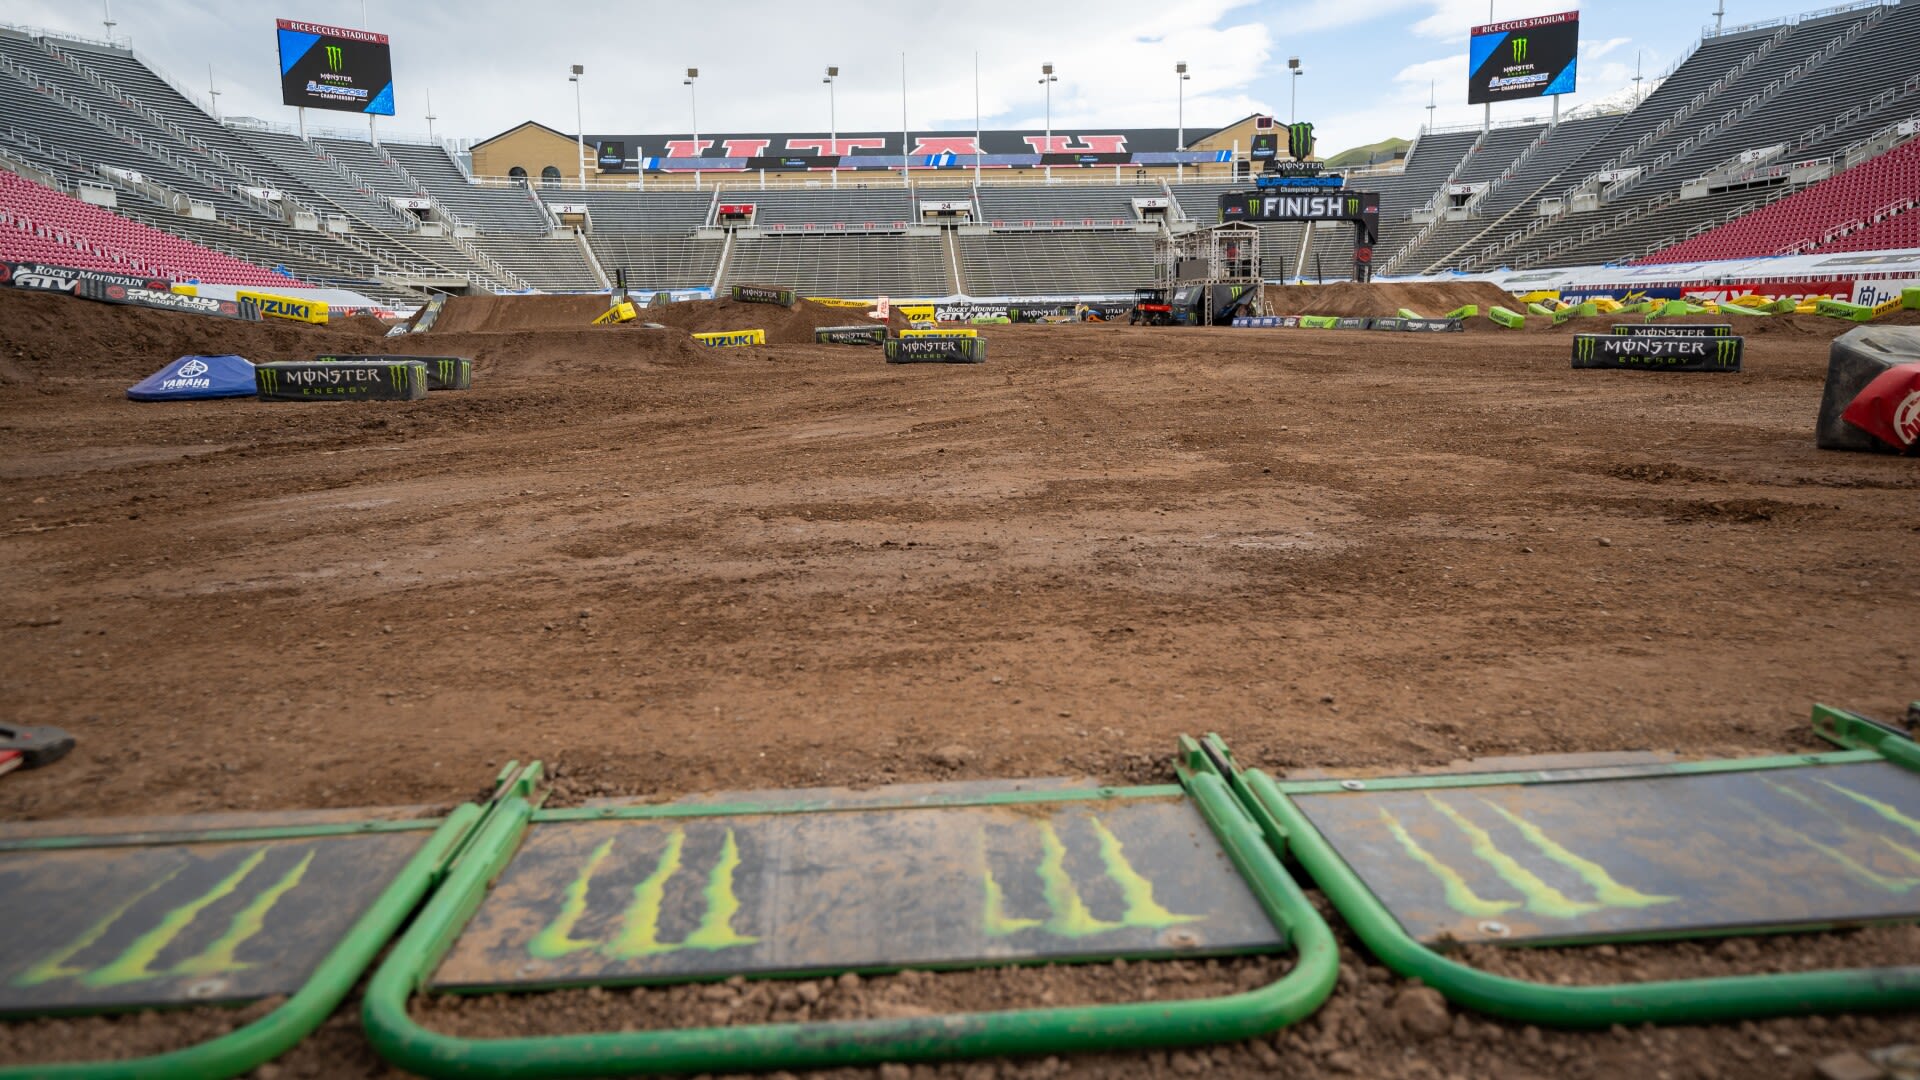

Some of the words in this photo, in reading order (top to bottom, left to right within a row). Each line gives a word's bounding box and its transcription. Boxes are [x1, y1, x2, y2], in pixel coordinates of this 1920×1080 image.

[1482, 20, 1528, 34] RICE-ECCLES
[1529, 14, 1566, 26] STADIUM
[291, 22, 340, 36] RICE-ECCLES
[341, 30, 377, 42] STADIUM
[1503, 63, 1535, 73] MONSTER
[320, 73, 353, 83] MONSTER
[305, 83, 369, 97] SUPERCROSS
[1277, 162, 1324, 171] MONSTER
[408, 200, 419, 208] 20
[1263, 197, 1343, 217] FINISH
[34, 265, 76, 279] ROCKY
[77, 270, 144, 287] MOUNTAIN
[742, 289, 778, 299] MONSTER
[832, 332, 872, 340] MONSTER
[1634, 327, 1705, 337] MONSTER
[700, 334, 754, 348] UZUKI
[902, 341, 956, 352] MONSTER
[1604, 338, 1706, 356] MONSTER
[1618, 355, 1689, 364] ENERGY
[286, 367, 381, 386] MONSTER
[162, 378, 211, 389] YAMAHA
[303, 386, 369, 395] ENERGY
